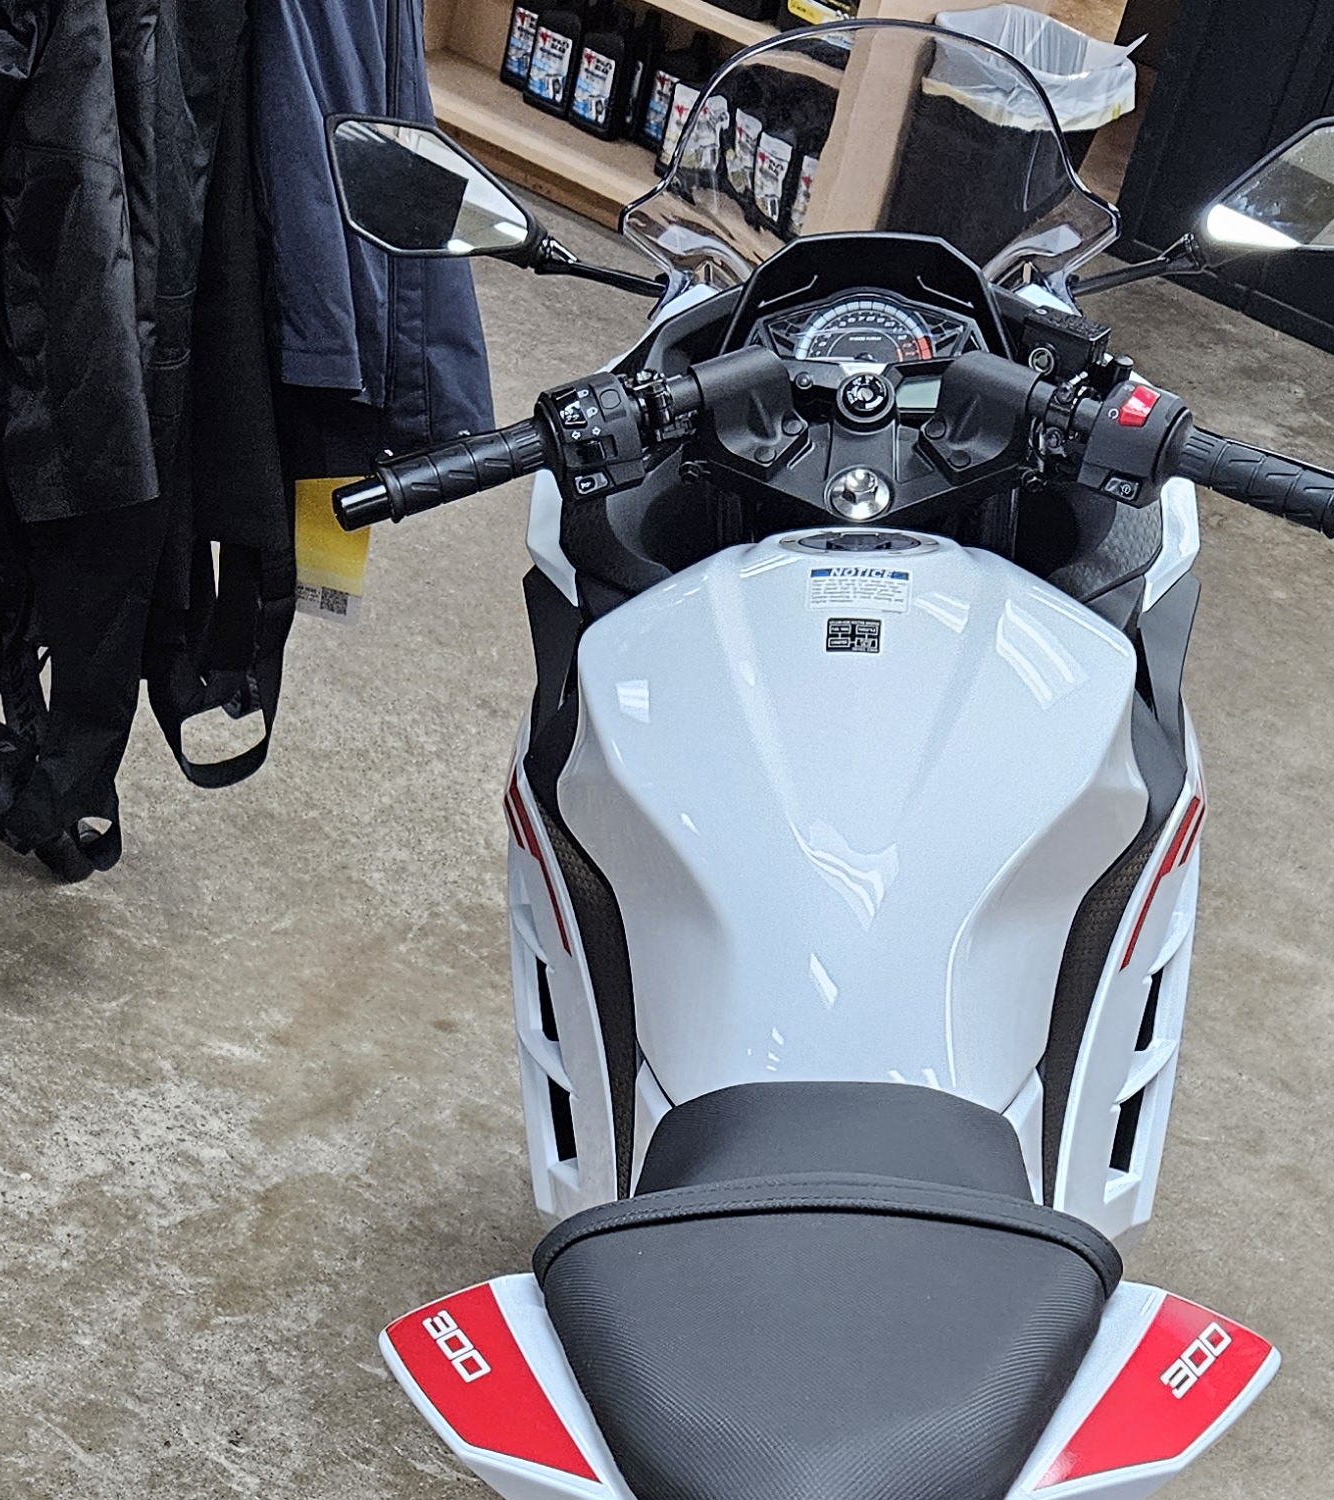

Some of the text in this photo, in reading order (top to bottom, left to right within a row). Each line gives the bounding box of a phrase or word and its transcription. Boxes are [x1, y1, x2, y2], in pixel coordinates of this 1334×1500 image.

[830, 567, 894, 579] NOTICE
[422, 1310, 492, 1383] 300
[1160, 1321, 1232, 1400] 300
